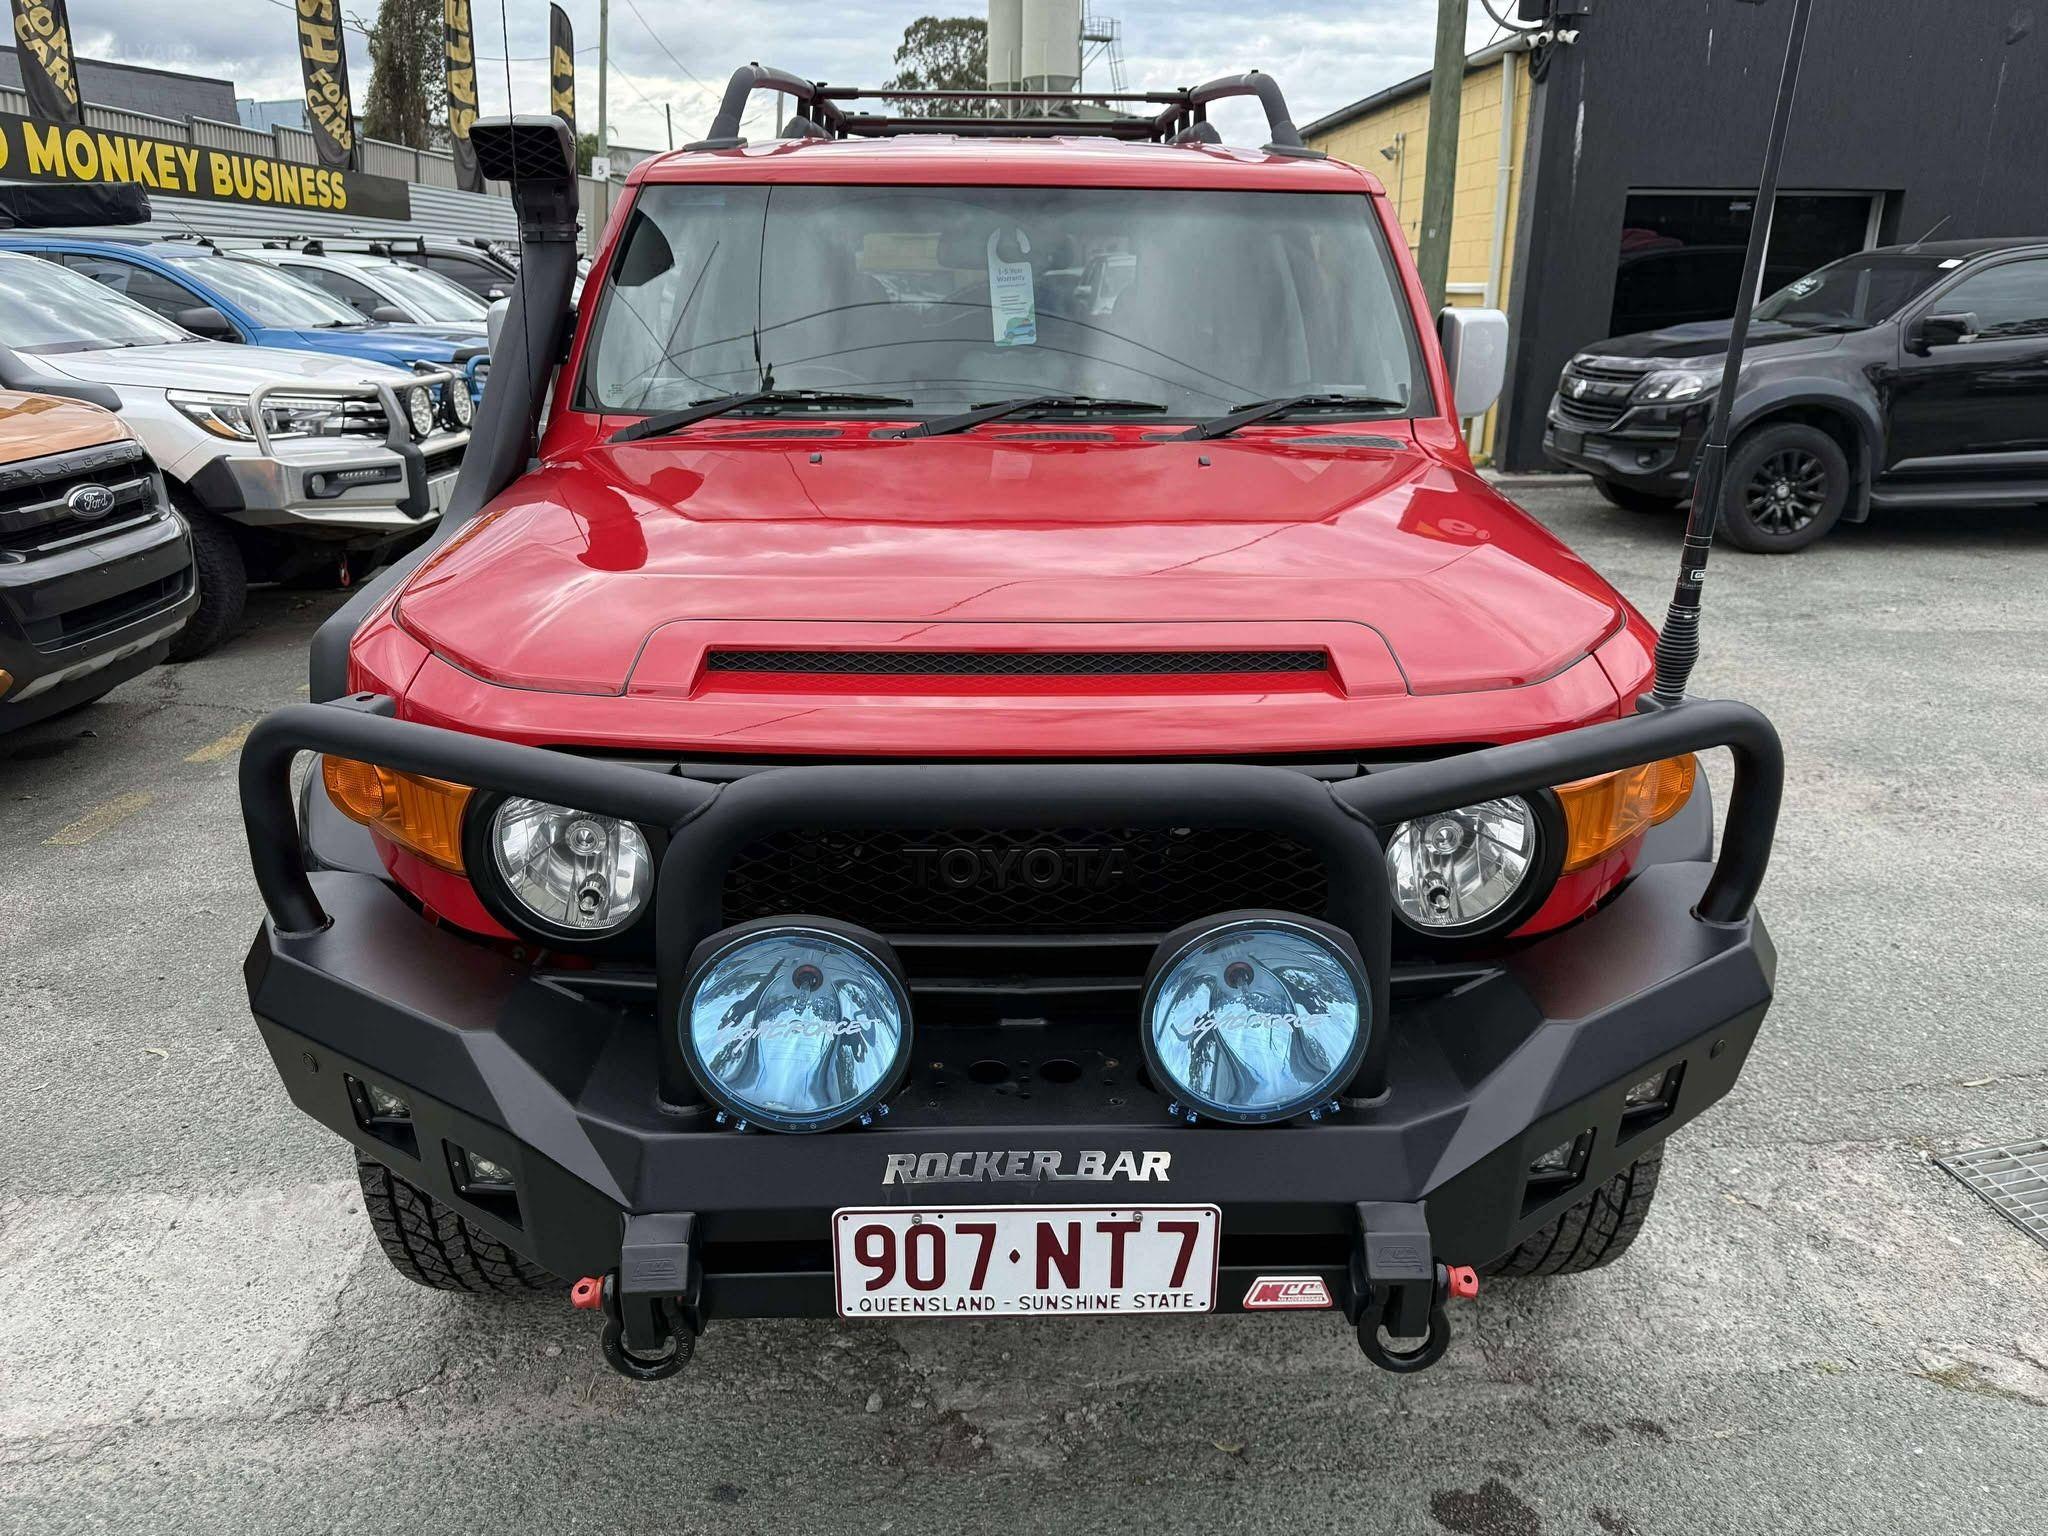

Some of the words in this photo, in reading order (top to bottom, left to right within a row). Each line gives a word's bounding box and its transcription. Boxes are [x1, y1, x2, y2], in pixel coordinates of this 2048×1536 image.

[15, 13, 78, 105] CARS
[309, 67, 349, 120] FOR
[307, 88, 352, 150] CARS
[22, 121, 200, 192] MONKEY
[209, 152, 347, 210] BUSINESS
[83, 491, 108, 511] Ford
[902, 847, 1137, 889] TOYOTA
[882, 1150, 1061, 1185] ROCKER
[1074, 1150, 1172, 1183] BAR
[858, 1297, 996, 1313] QUEENSLAND
[1018, 1294, 1121, 1312] SUNSHINE
[1133, 1292, 1194, 1309] STATE
[1253, 1283, 1323, 1302] MCC
